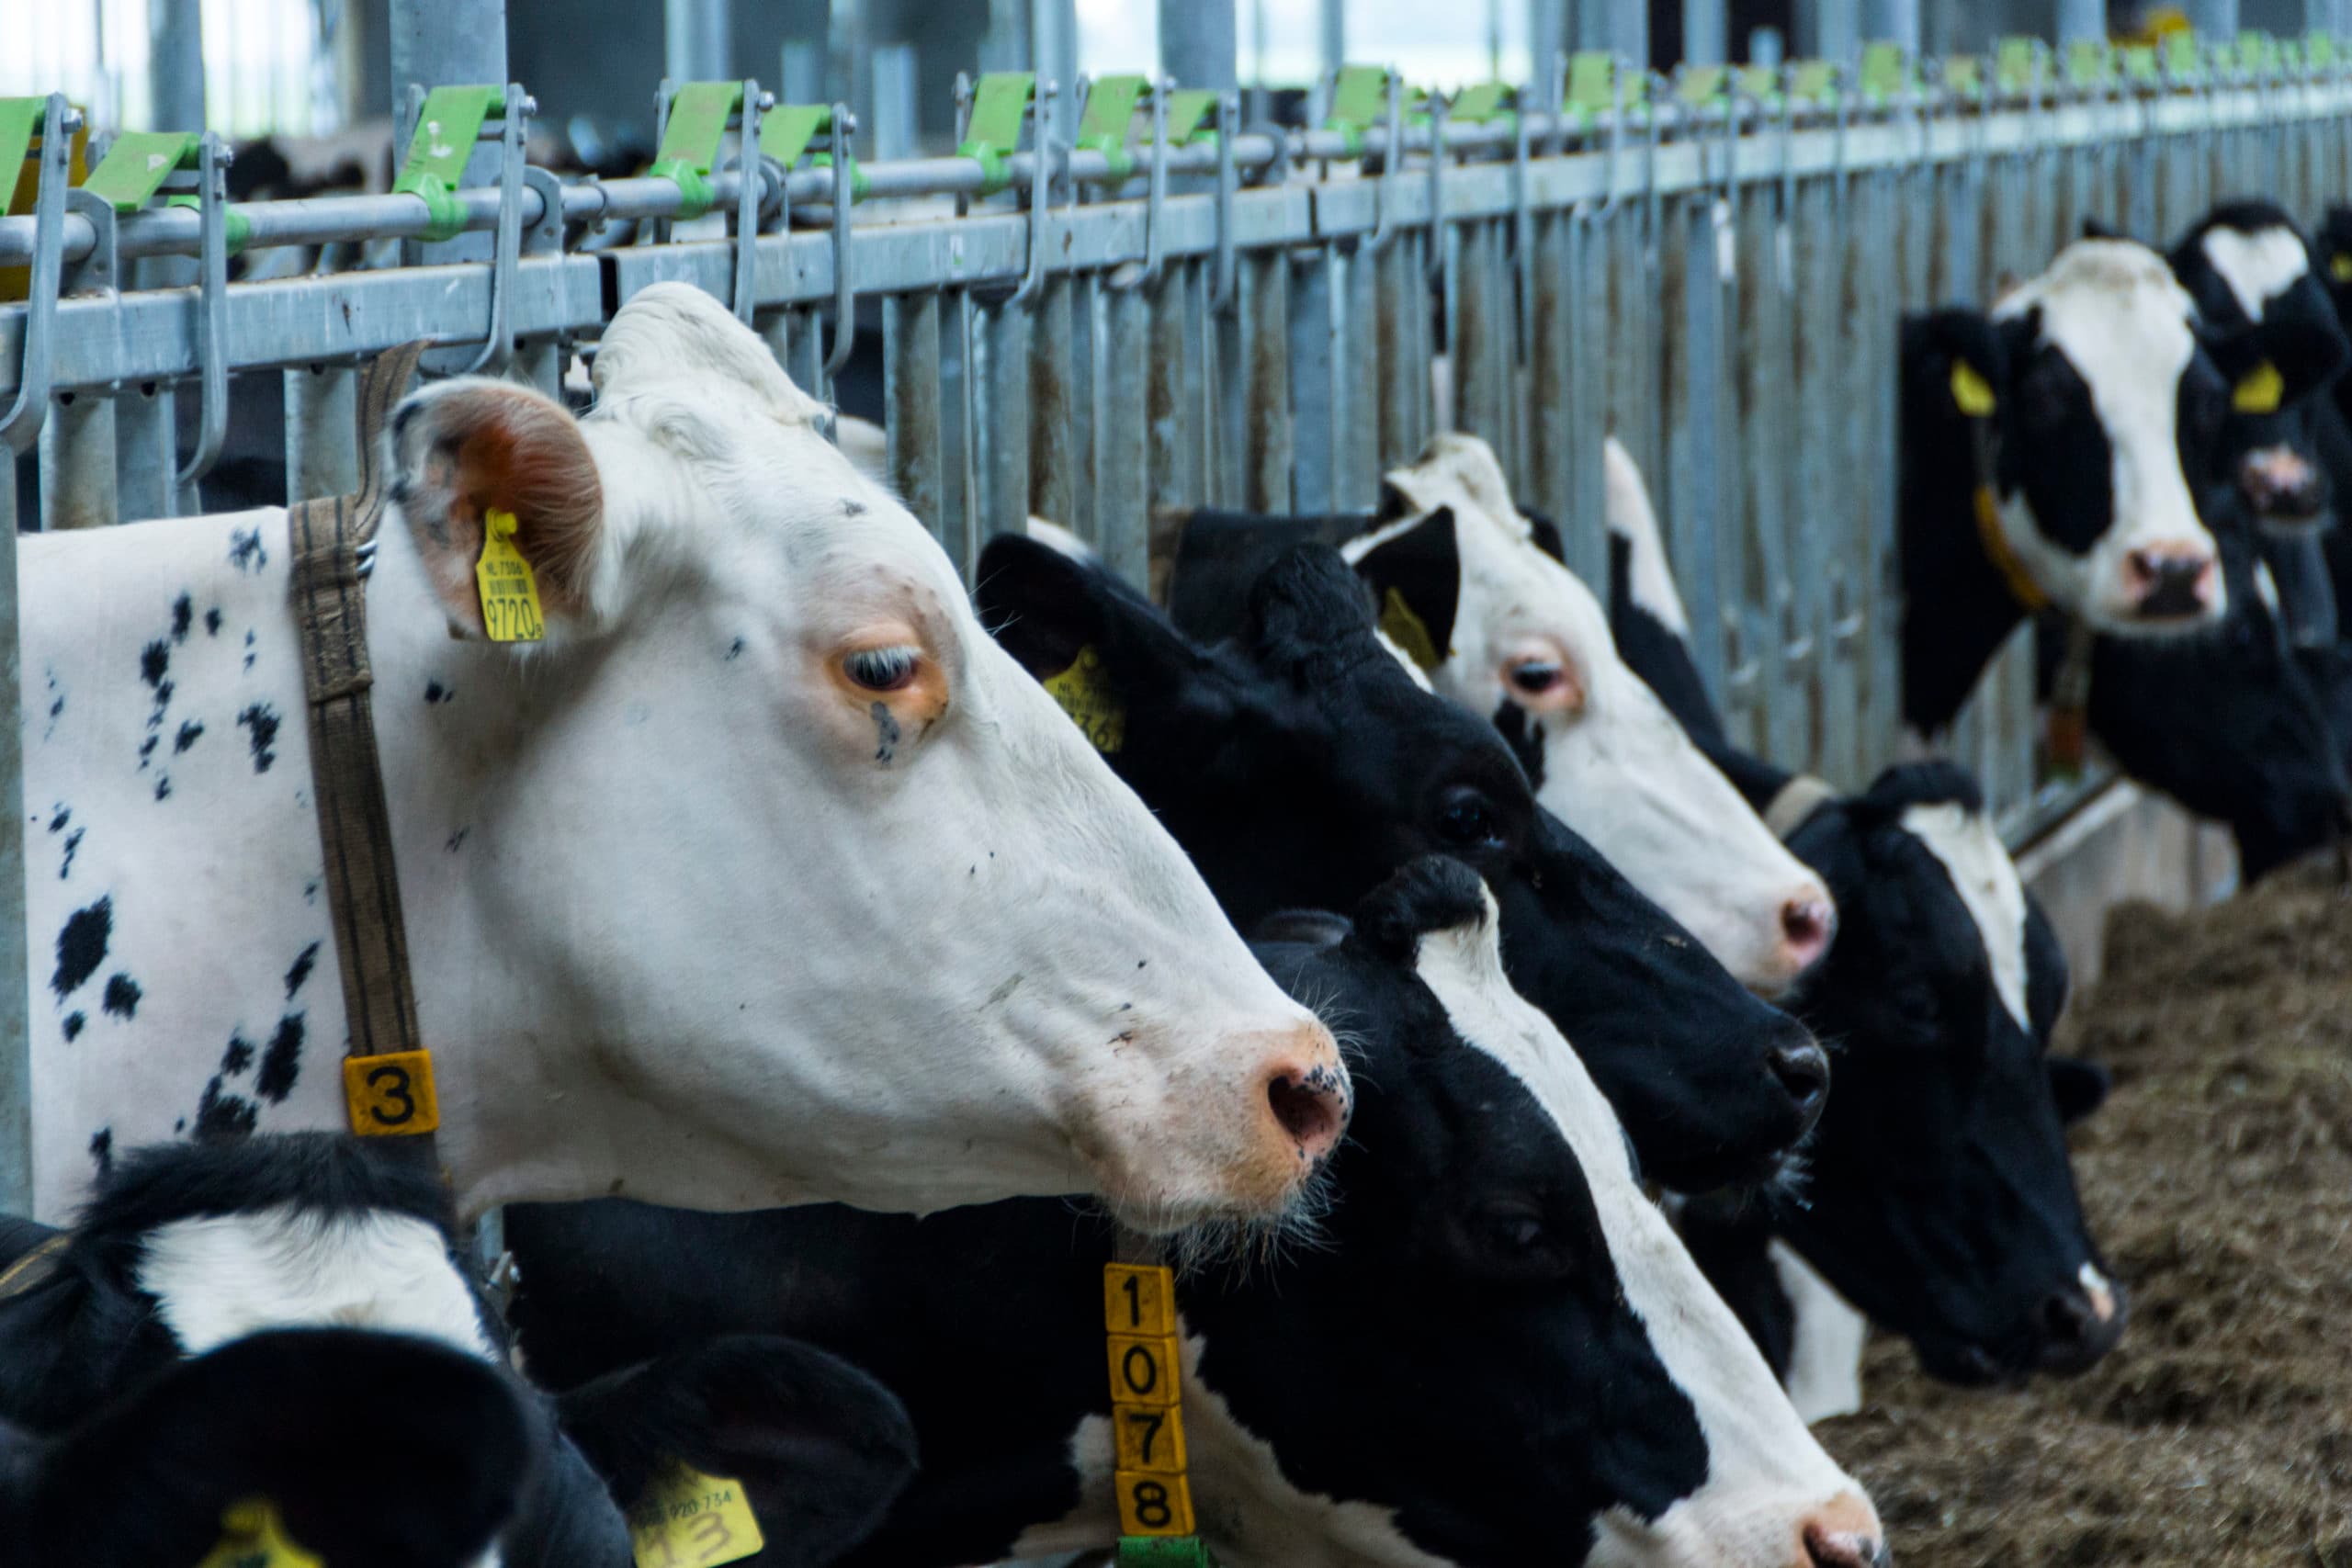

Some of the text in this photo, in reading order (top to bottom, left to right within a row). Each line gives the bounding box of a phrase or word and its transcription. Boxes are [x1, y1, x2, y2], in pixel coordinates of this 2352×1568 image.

[487, 598, 536, 639] 9720
[367, 1066, 415, 1126] 3
[1122, 1274, 1171, 1529] 1078
